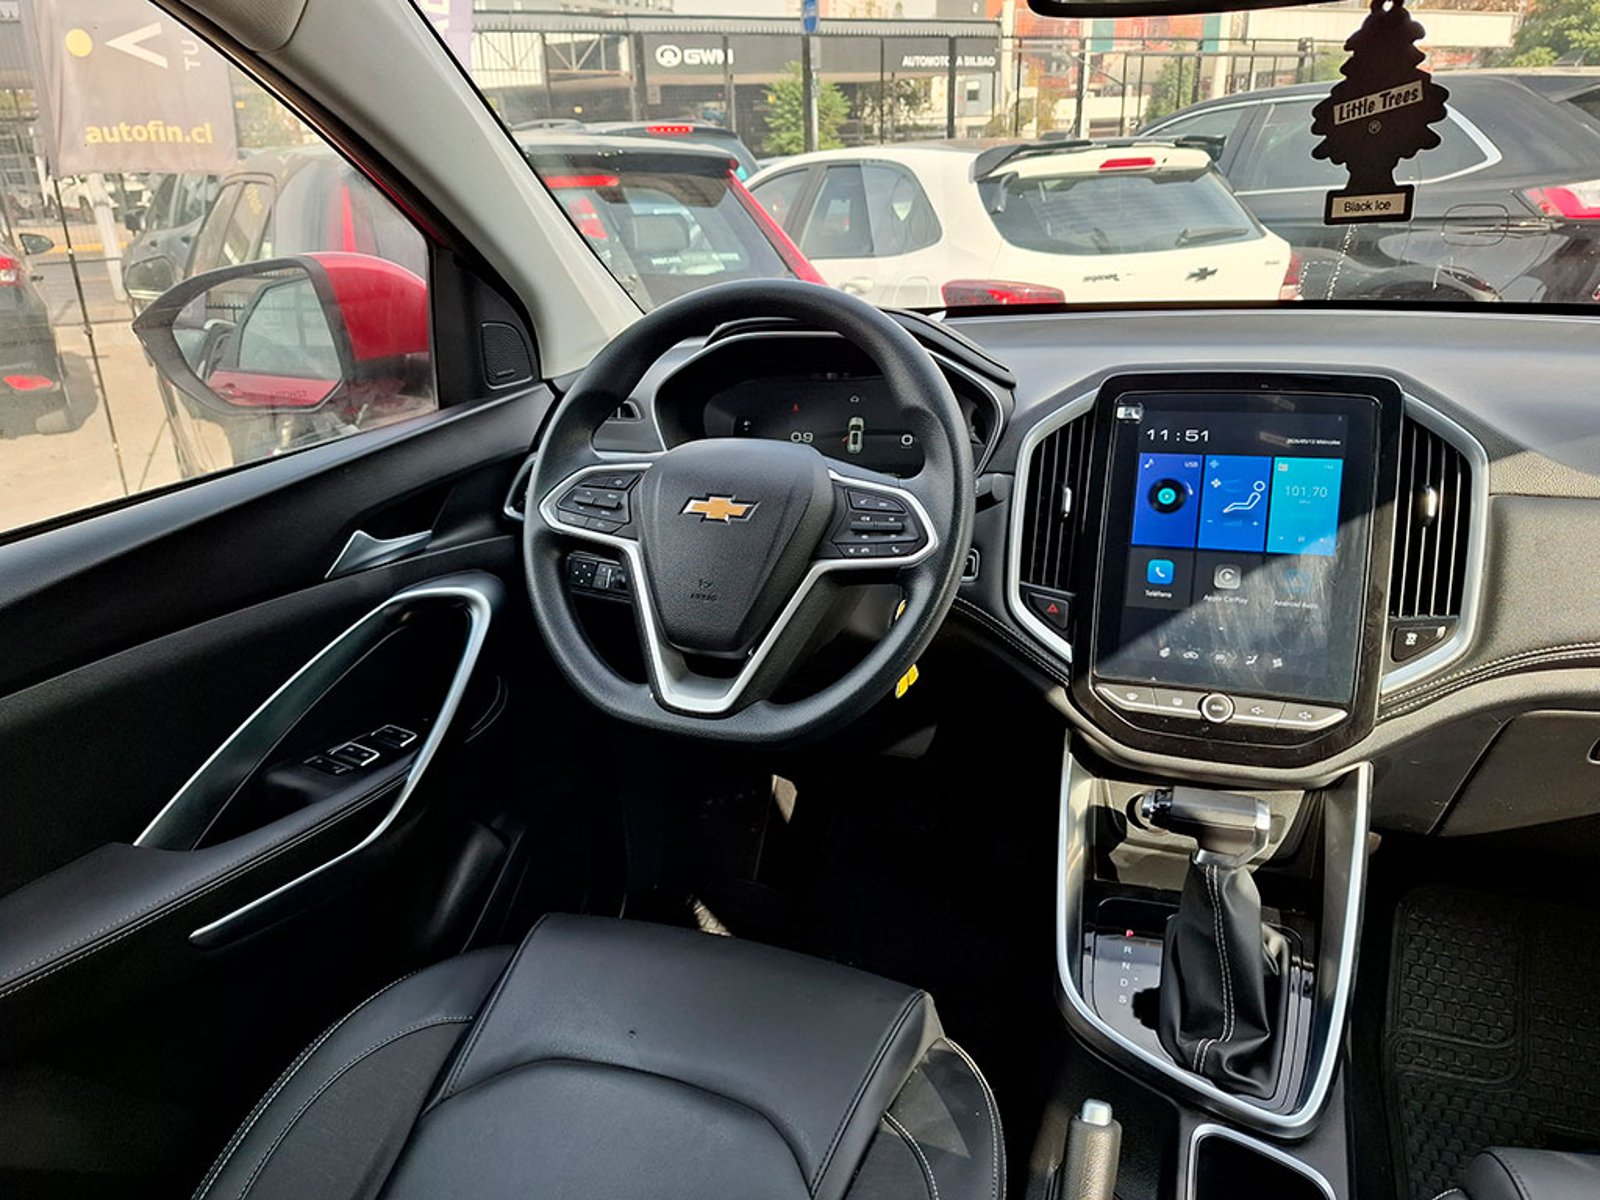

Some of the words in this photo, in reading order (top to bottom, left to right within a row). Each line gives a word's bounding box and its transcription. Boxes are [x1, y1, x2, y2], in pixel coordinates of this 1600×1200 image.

[1338, 97, 1376, 122] Little
[1379, 87, 1419, 110] Trees
[86, 121, 213, 143] autofin.cl
[1343, 200, 1372, 213] Black
[1374, 199, 1392, 211] Ice
[1146, 429, 1210, 443] 11:51
[1285, 485, 1328, 499] 101.70
